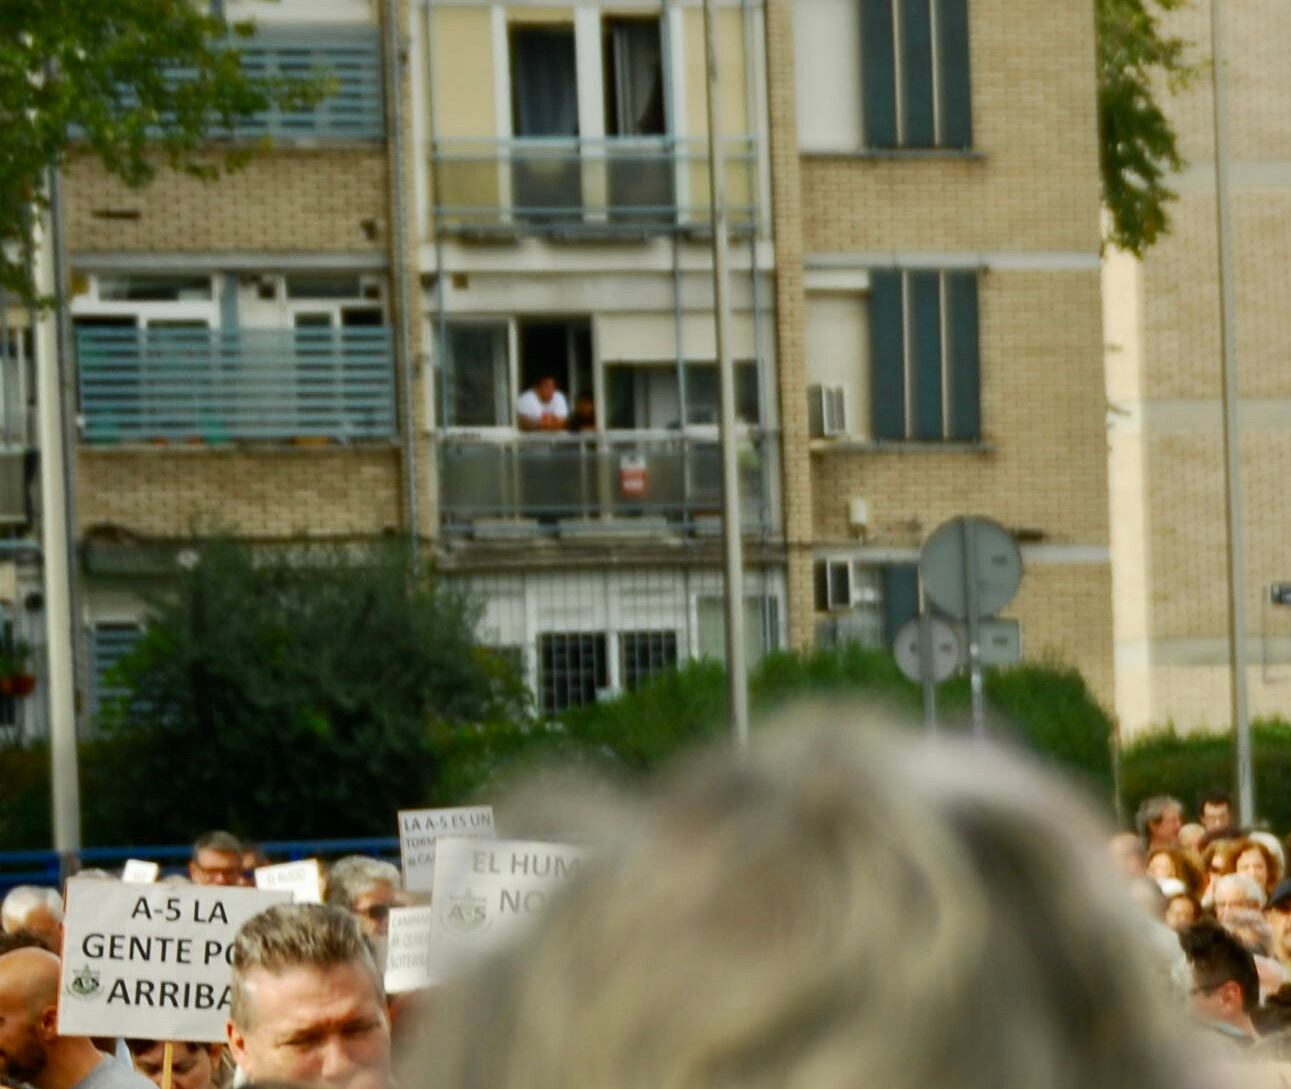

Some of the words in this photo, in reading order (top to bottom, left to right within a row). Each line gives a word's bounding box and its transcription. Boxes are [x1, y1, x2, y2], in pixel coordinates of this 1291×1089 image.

[403, 817, 422, 832] LA
[470, 812, 491, 827] UN
[473, 850, 500, 874] EL
[131, 896, 182, 921] A-5
[193, 900, 229, 925] LA
[82, 932, 193, 965] GENTE
